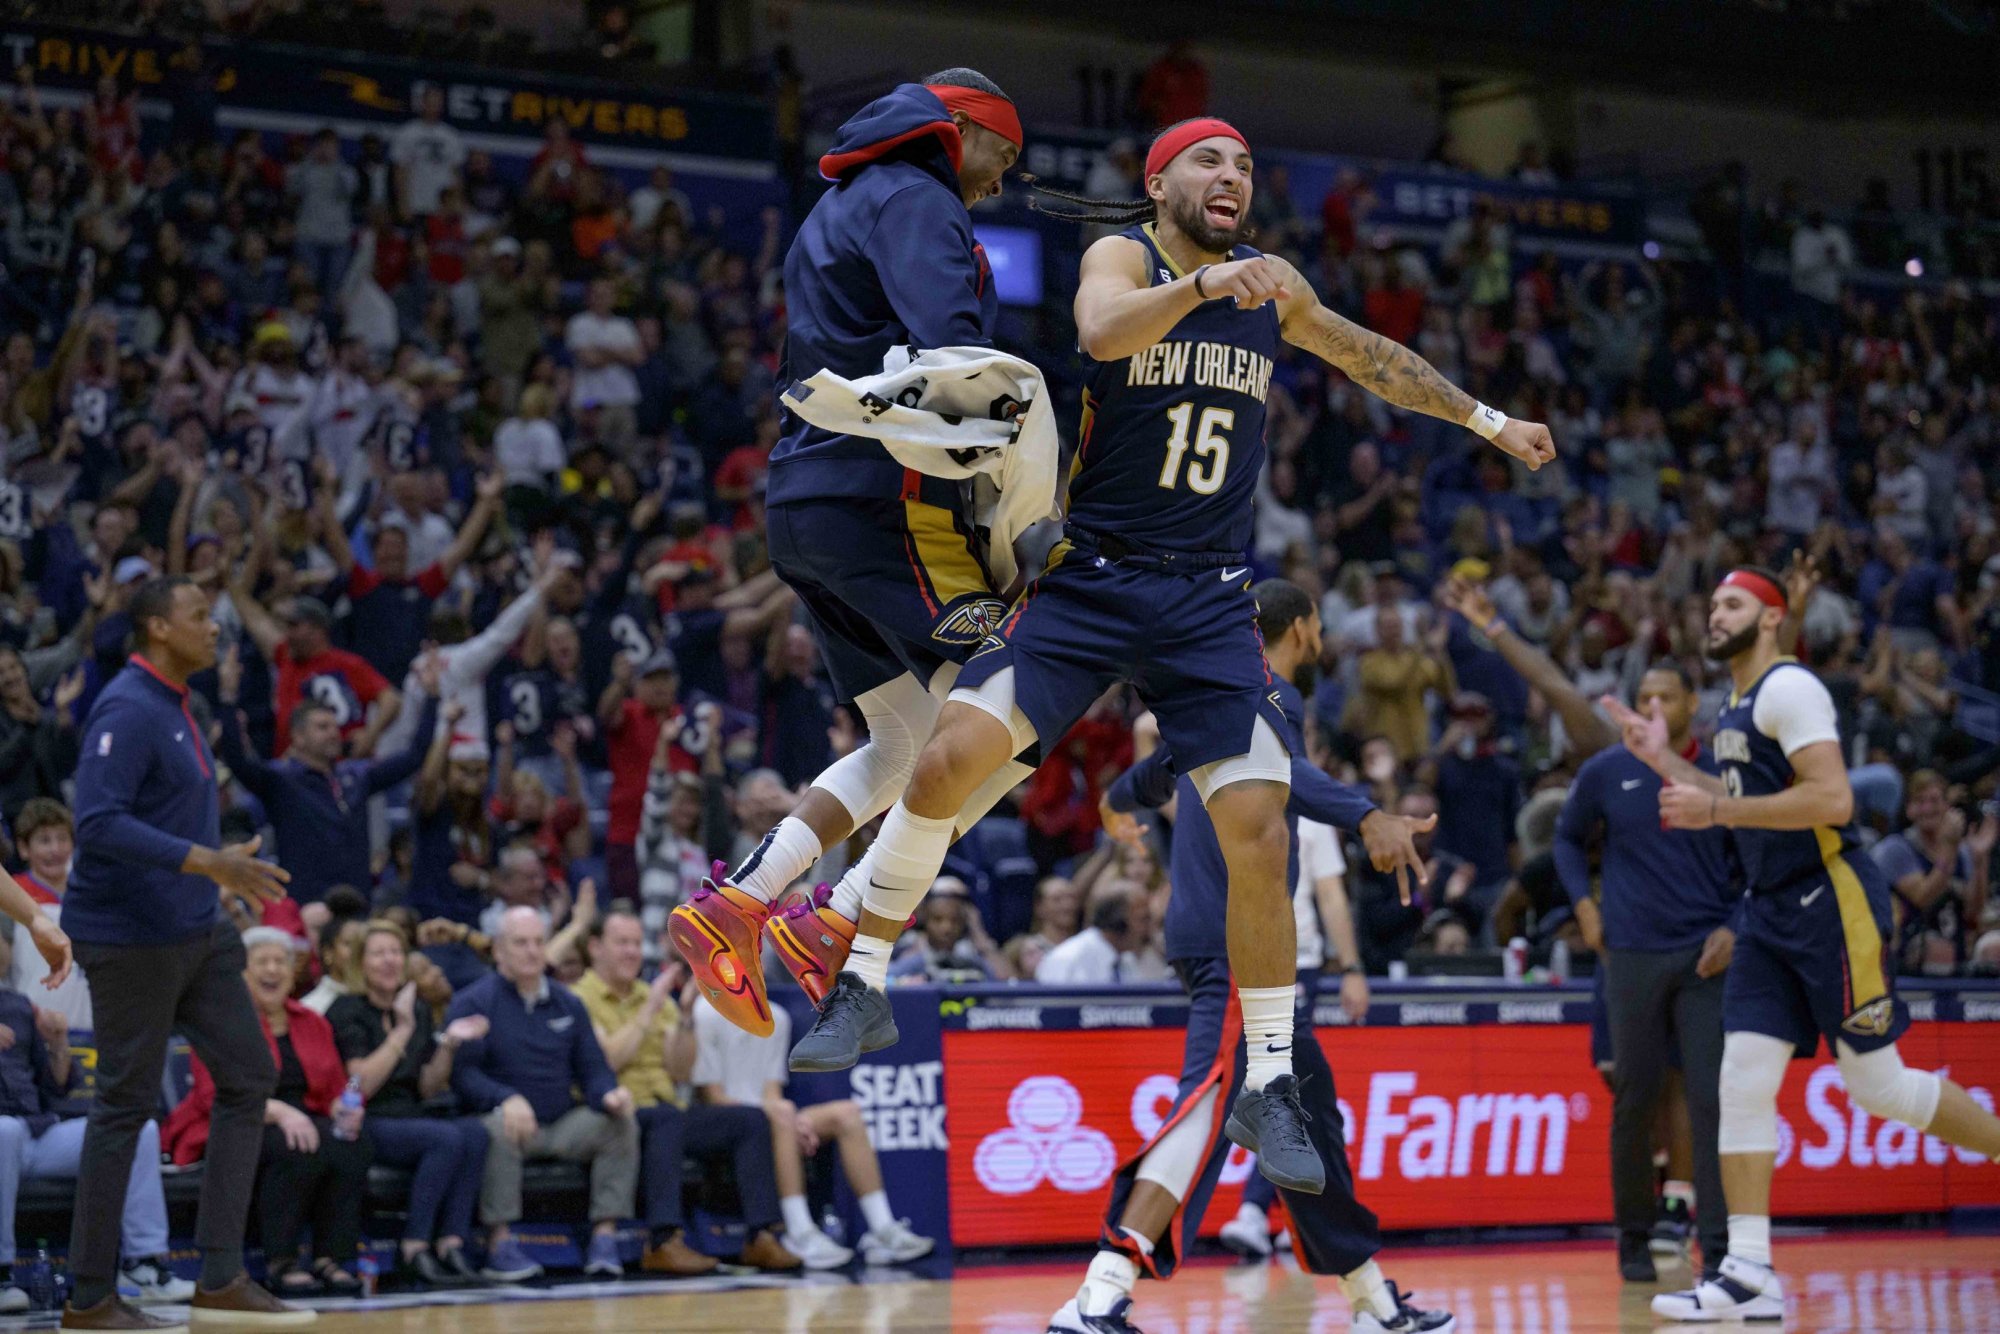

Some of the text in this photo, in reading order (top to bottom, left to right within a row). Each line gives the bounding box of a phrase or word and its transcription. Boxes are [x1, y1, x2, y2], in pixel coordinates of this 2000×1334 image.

[1, 32, 238, 94] TRIVE
[1127, 340, 1274, 405] NEW ORLEANS
[1158, 401, 1235, 495] 15
[509, 680, 542, 735] 3
[849, 1060, 943, 1107] SEAT
